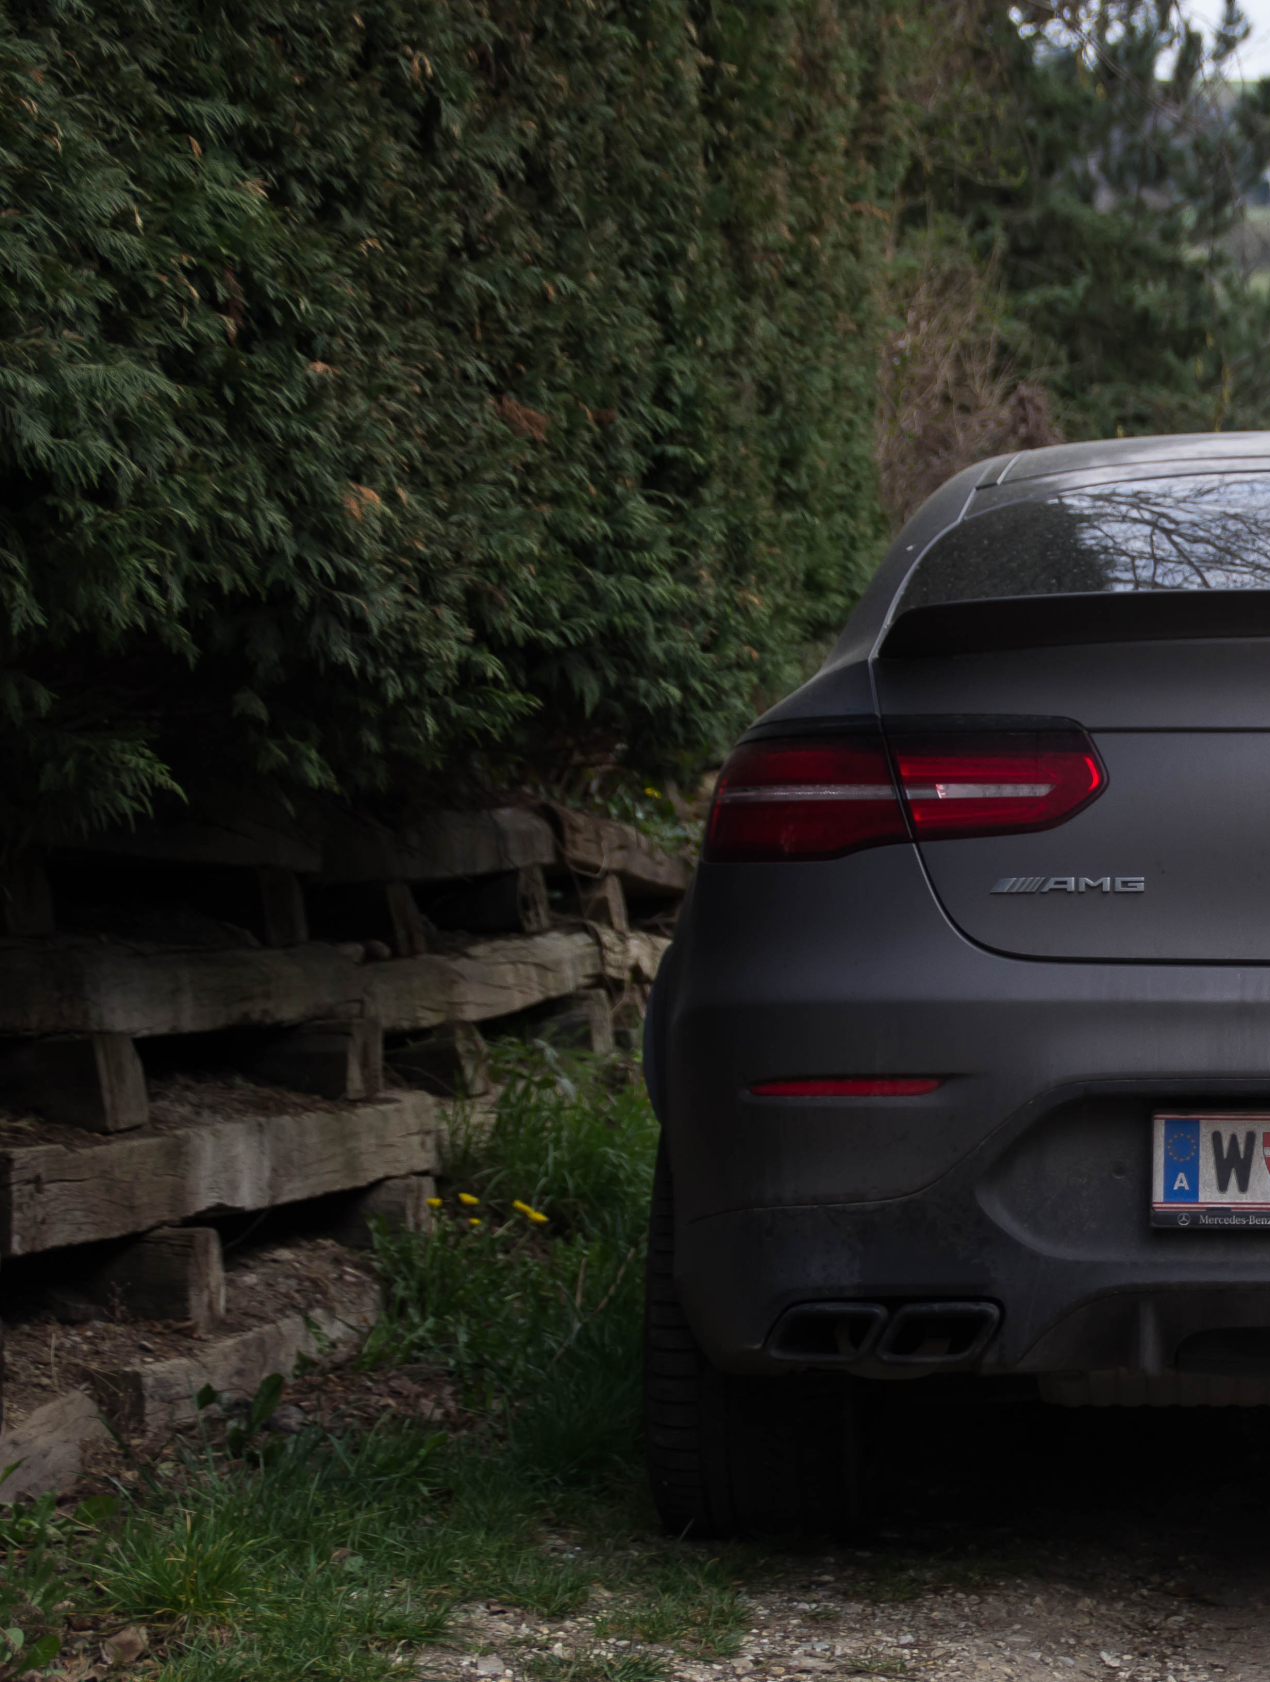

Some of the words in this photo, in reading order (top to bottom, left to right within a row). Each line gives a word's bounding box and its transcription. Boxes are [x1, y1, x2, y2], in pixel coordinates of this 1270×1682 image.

[1039, 877, 1145, 893] AMG
[1211, 1130, 1256, 1194] W
[1172, 1172, 1190, 1191] A
